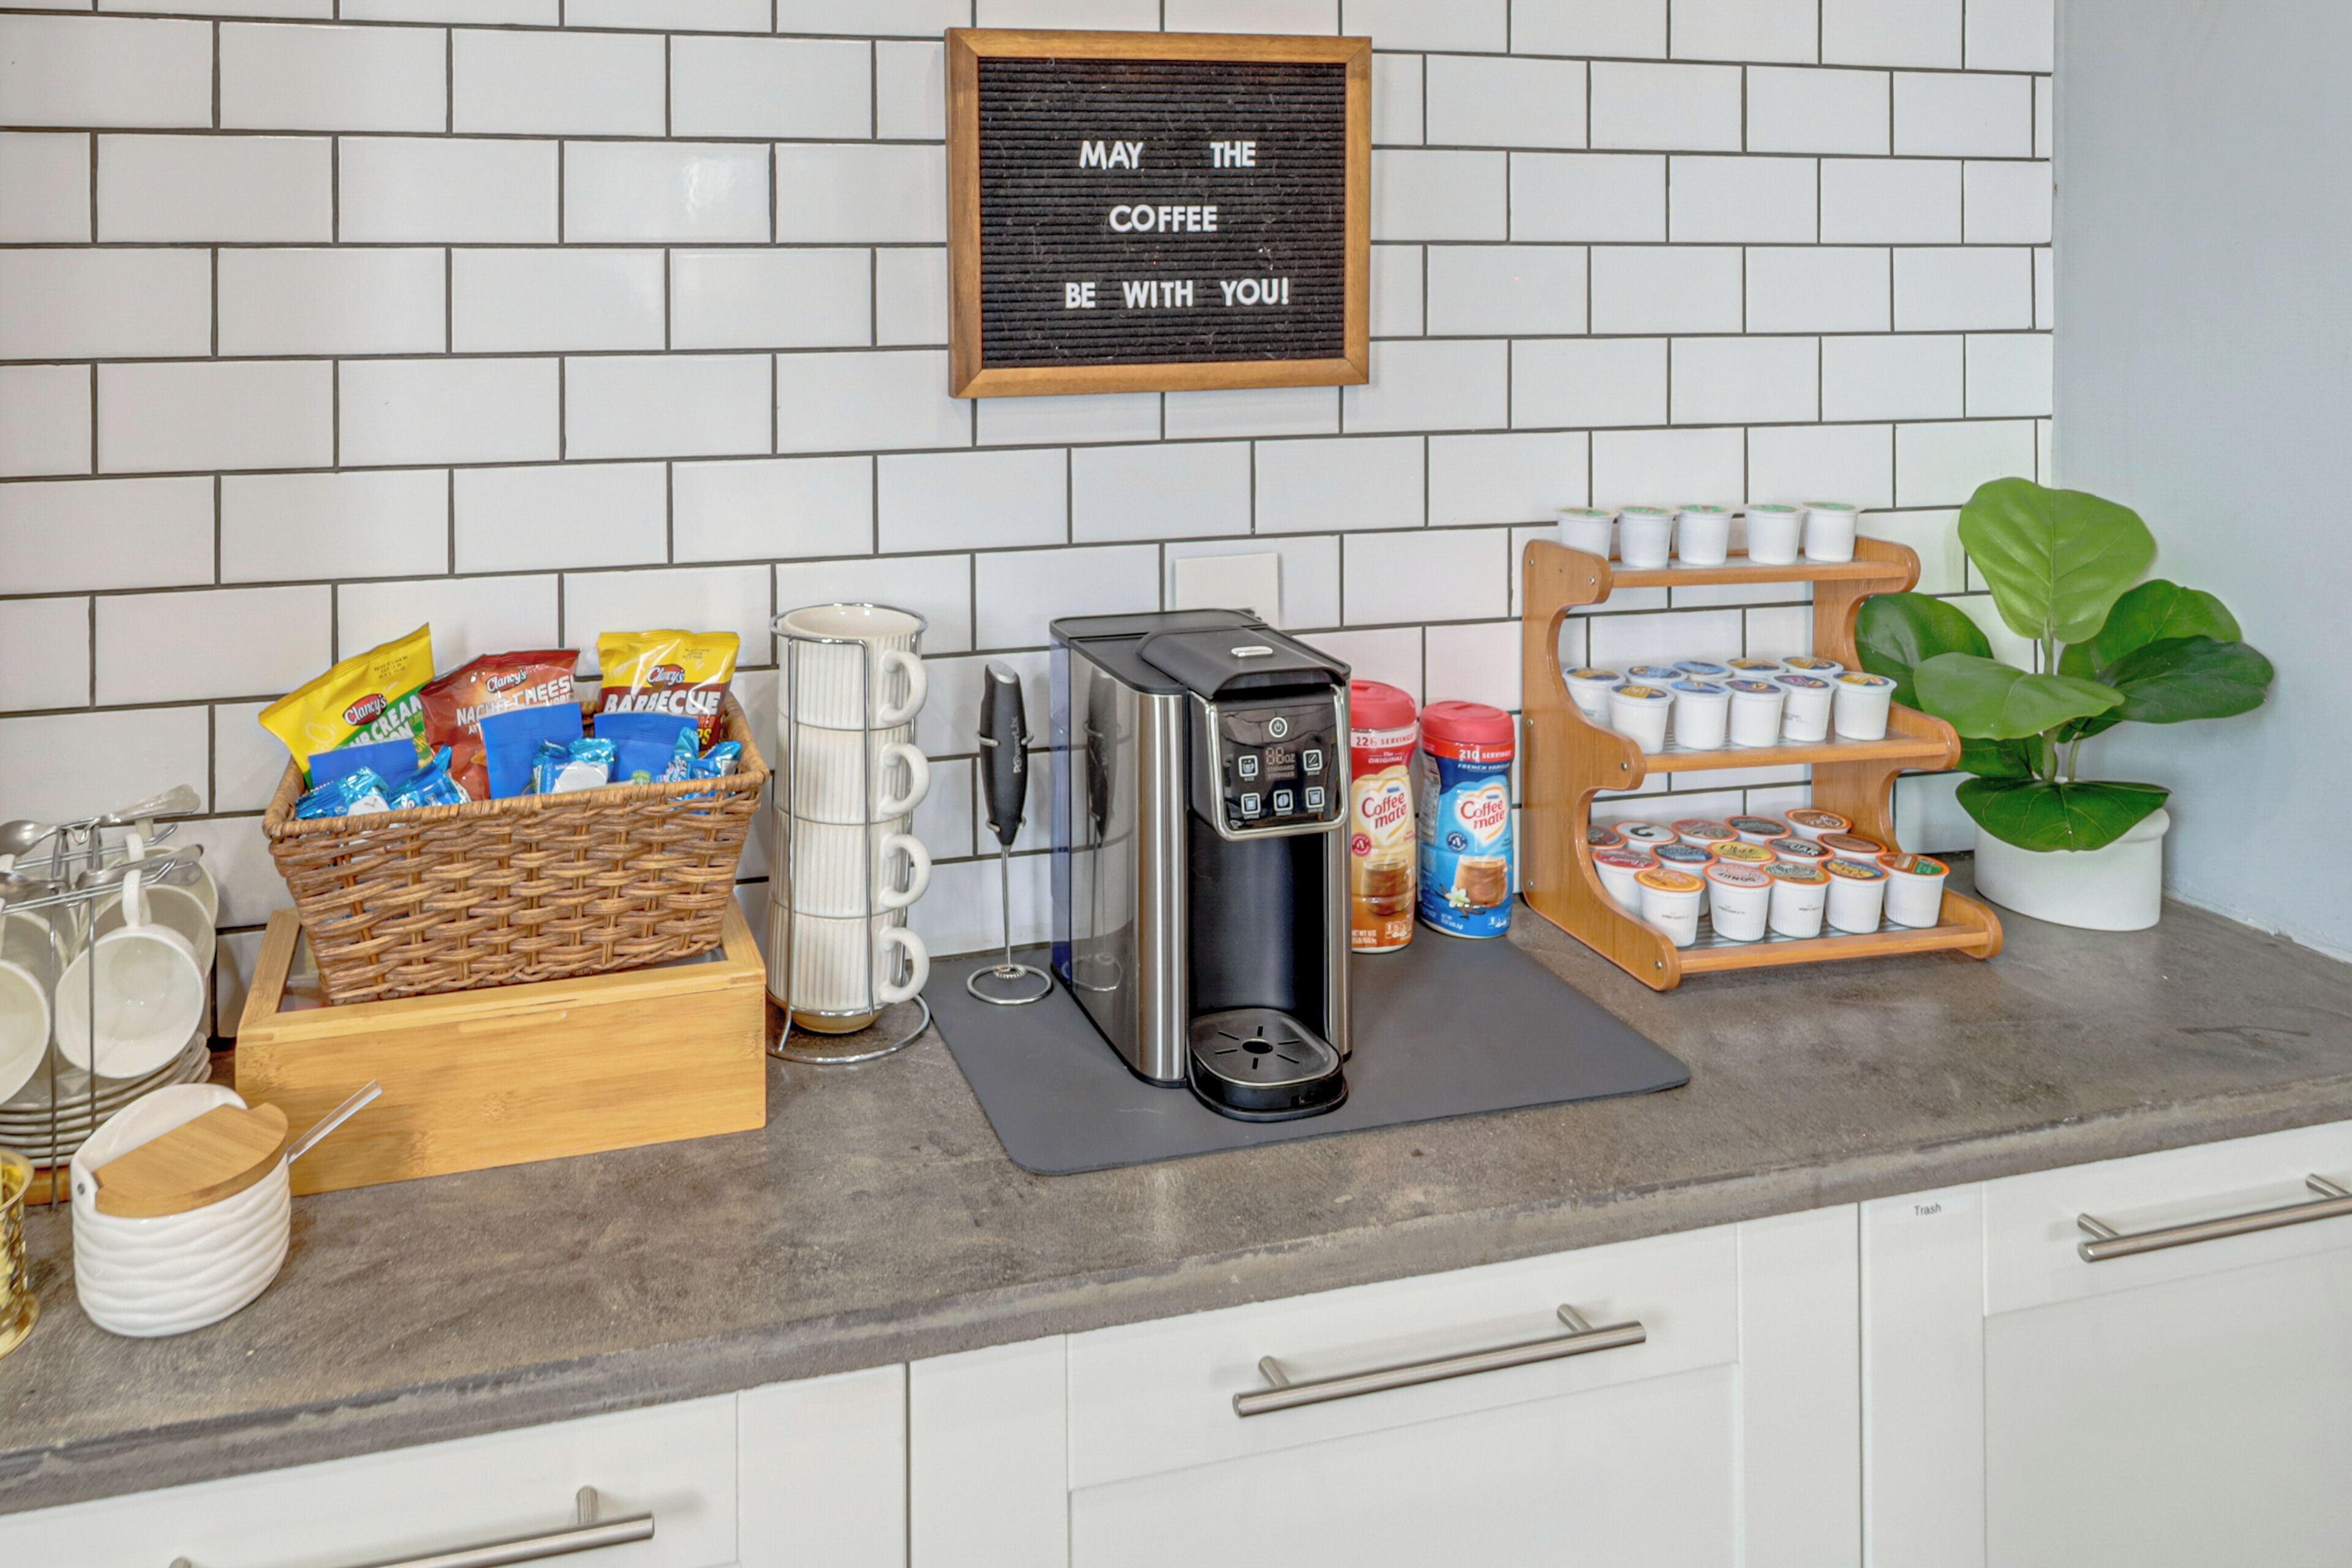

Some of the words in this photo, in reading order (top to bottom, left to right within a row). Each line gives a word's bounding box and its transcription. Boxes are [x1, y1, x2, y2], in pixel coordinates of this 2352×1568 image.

[1079, 140, 1144, 170] MAY
[1210, 141, 1256, 168] THE
[1109, 205, 1218, 232] COFFEE
[1065, 282, 1096, 308] BE
[1123, 280, 1193, 308] WITH
[1220, 277, 1289, 306] YOU!
[486, 669, 527, 693] Clancy's
[344, 694, 388, 725] Clancy's
[603, 690, 722, 715] BARBECUE
[1368, 756, 1403, 764] ORIGINAL
[1362, 793, 1404, 818] Coffee
[1374, 803, 1407, 829] mate
[1460, 800, 1503, 820] Coffee
[1474, 810, 1505, 829] mate
[1914, 1202, 1942, 1216] Trash
